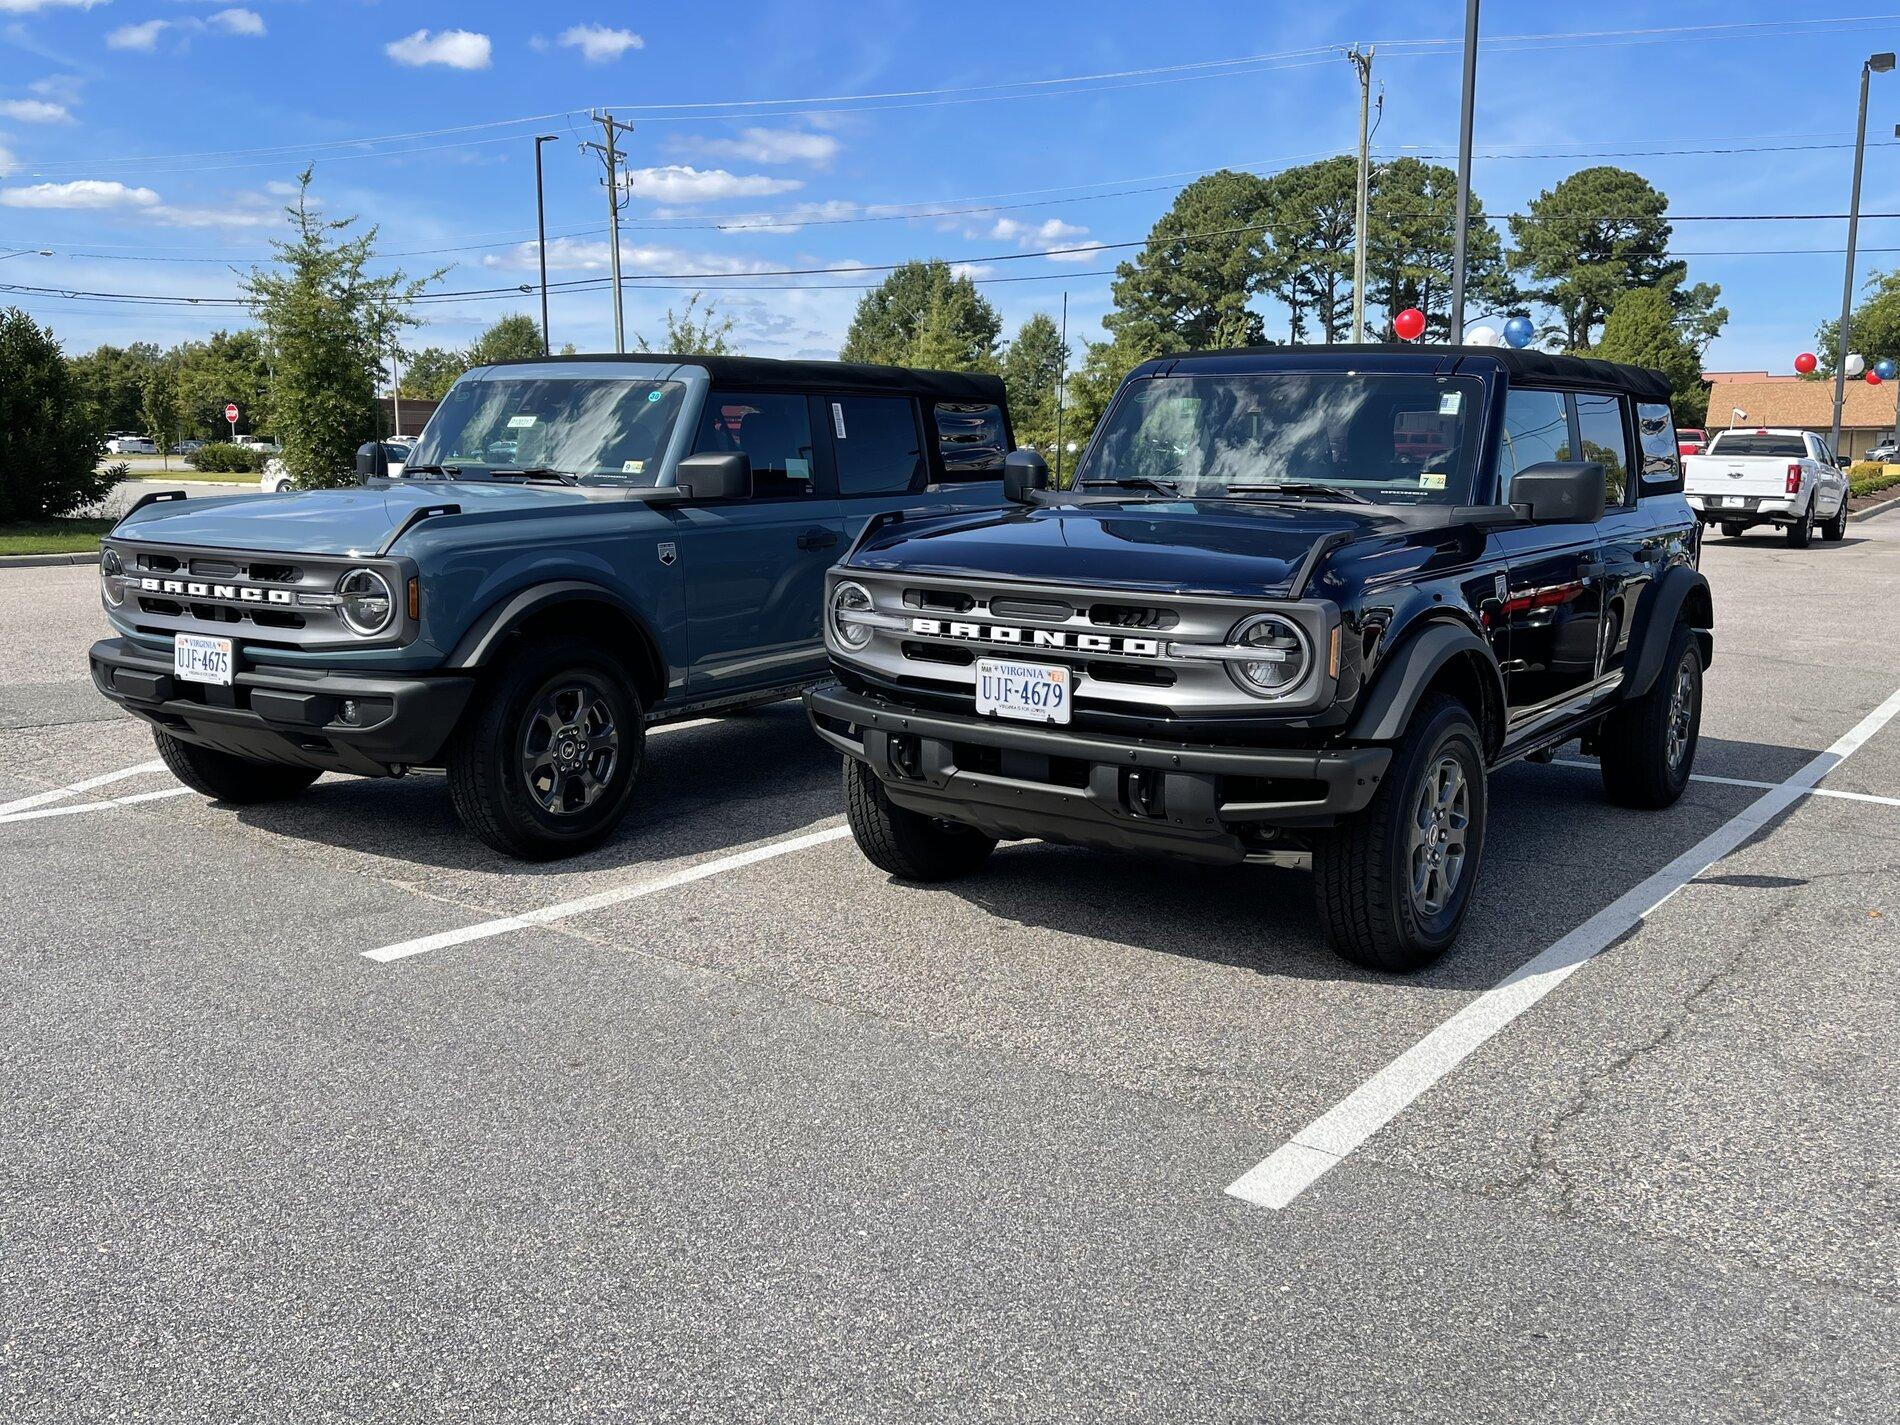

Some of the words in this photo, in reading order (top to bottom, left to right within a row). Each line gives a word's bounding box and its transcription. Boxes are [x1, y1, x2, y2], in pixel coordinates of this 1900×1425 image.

[1423, 477, 1429, 486] 7
[141, 578, 291, 603] BRONCO
[190, 639, 217, 650] VIRGINIA
[912, 618, 1158, 655] BRONCO
[178, 647, 228, 673] UJF-4675
[1000, 665, 1044, 679] VIRGINIA
[982, 675, 1063, 708] UJF-4679
